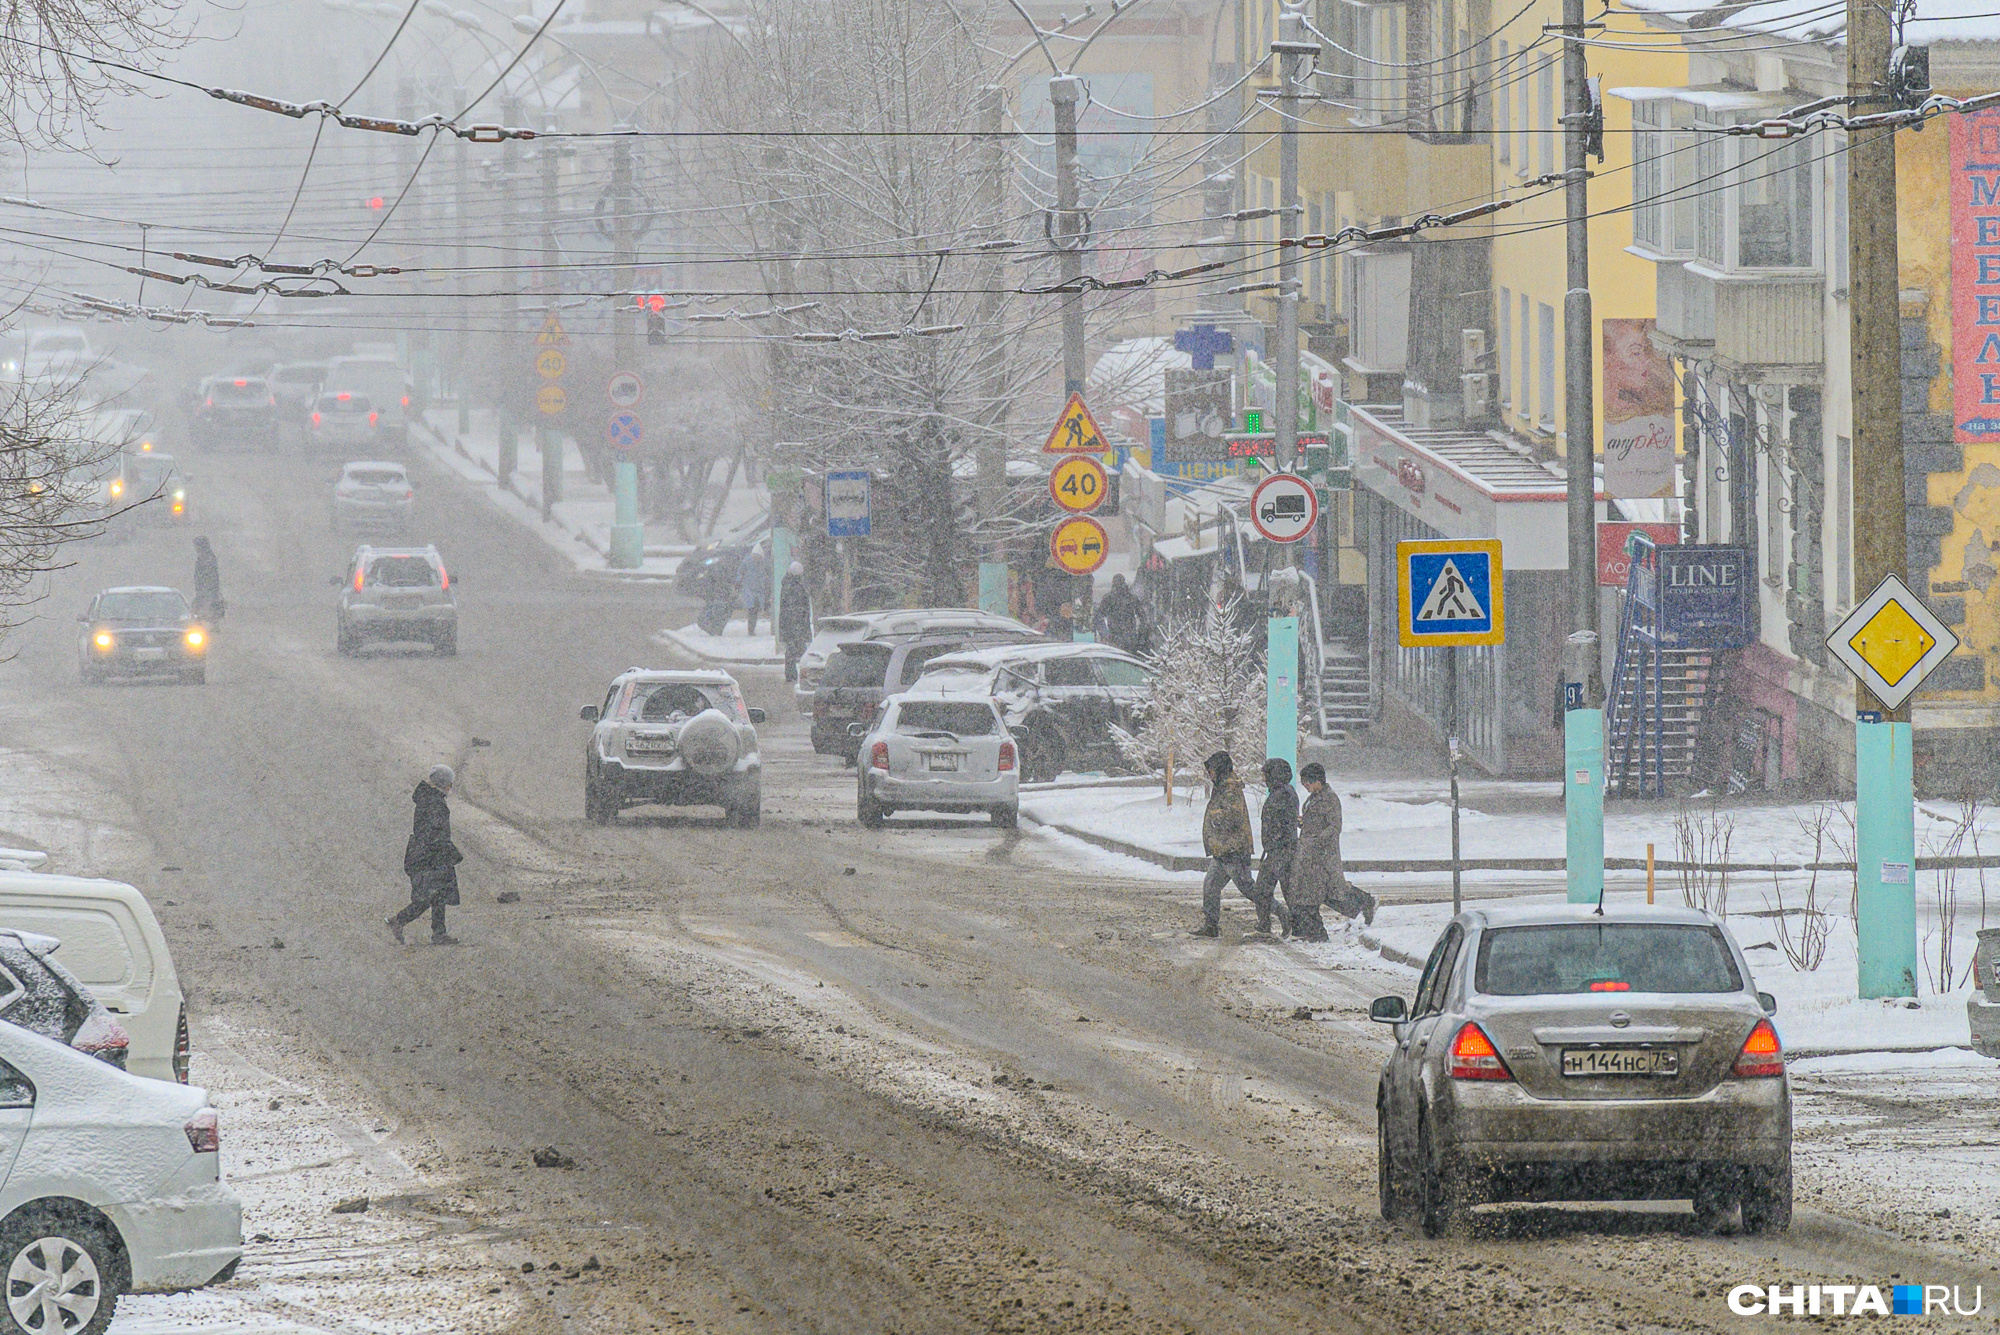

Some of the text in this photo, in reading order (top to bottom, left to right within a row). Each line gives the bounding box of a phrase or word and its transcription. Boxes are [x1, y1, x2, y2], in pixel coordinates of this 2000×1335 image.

[1179, 463, 1239, 480] ЦЕНЫ
[1061, 473, 1097, 496] 40
[1669, 564, 1737, 587] LINE
